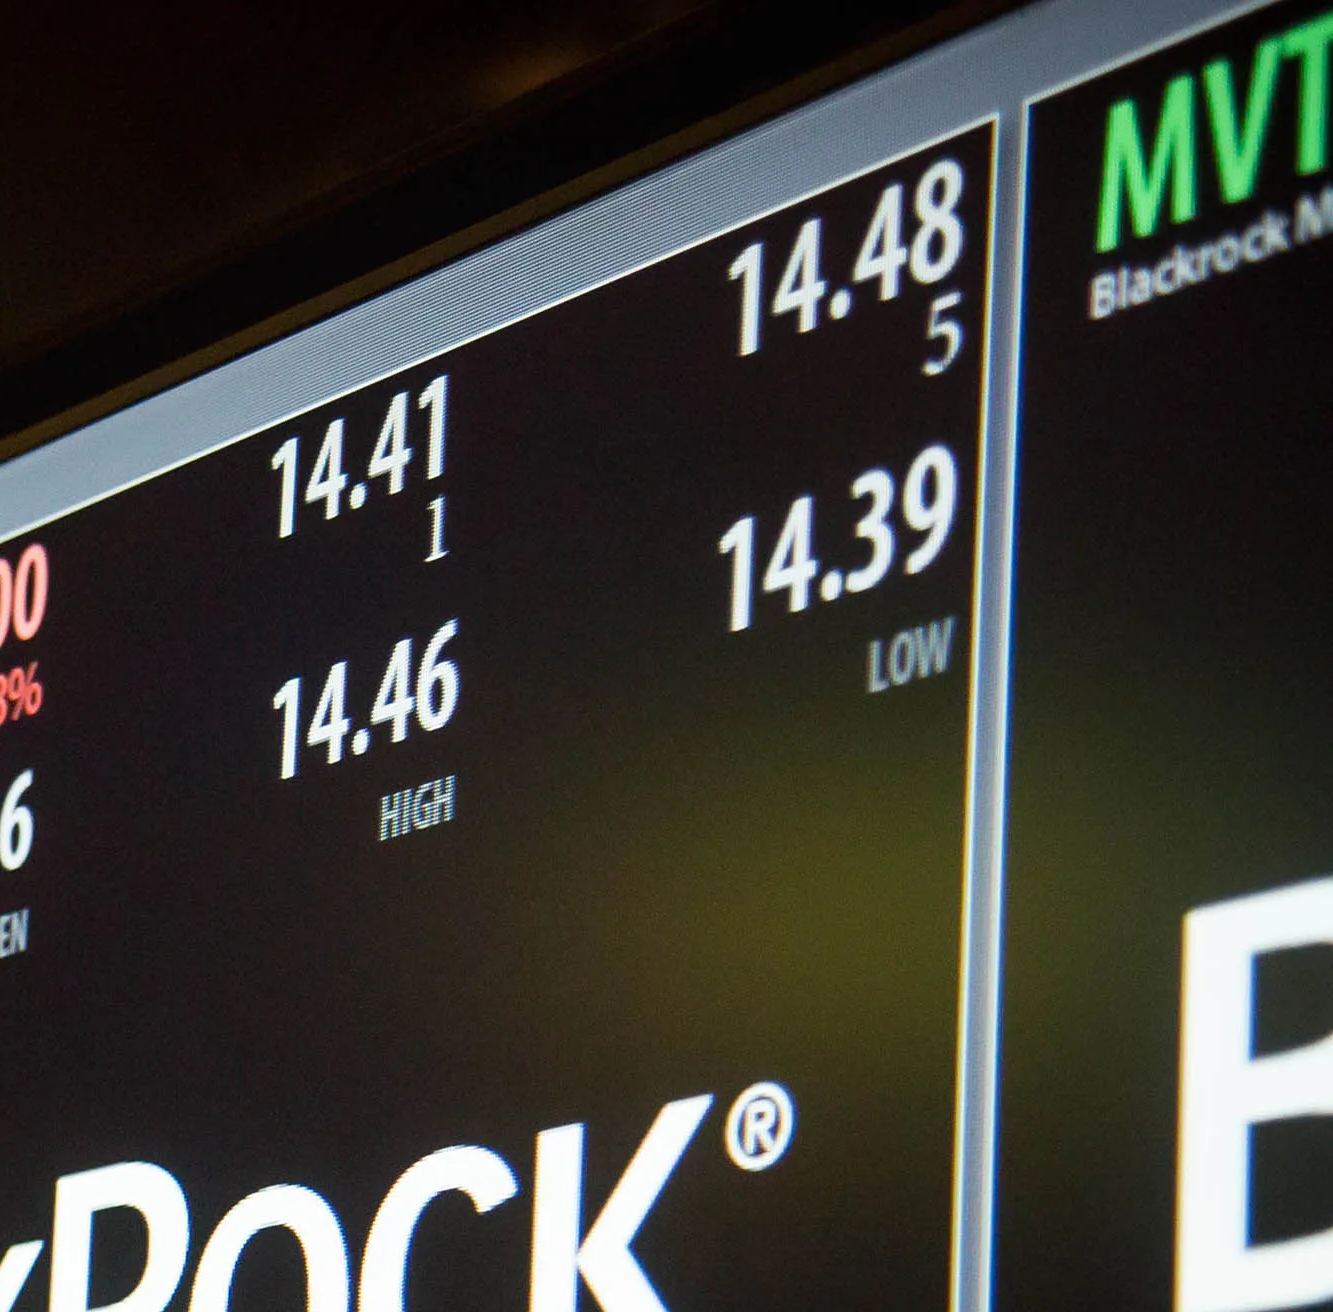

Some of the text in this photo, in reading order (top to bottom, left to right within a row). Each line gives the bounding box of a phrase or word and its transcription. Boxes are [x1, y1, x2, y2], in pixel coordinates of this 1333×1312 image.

[1095, 8, 1333, 253] MVT
[726, 158, 965, 357] 14.48
[1089, 208, 1290, 321] Blackrock
[922, 290, 965, 376] 5
[271, 374, 449, 539] 14.41
[424, 495, 450, 563] 1
[719, 443, 959, 632] 14.39
[272, 618, 461, 780] 14.46
[867, 616, 957, 695] LOW
[378, 774, 456, 842] HIGH
